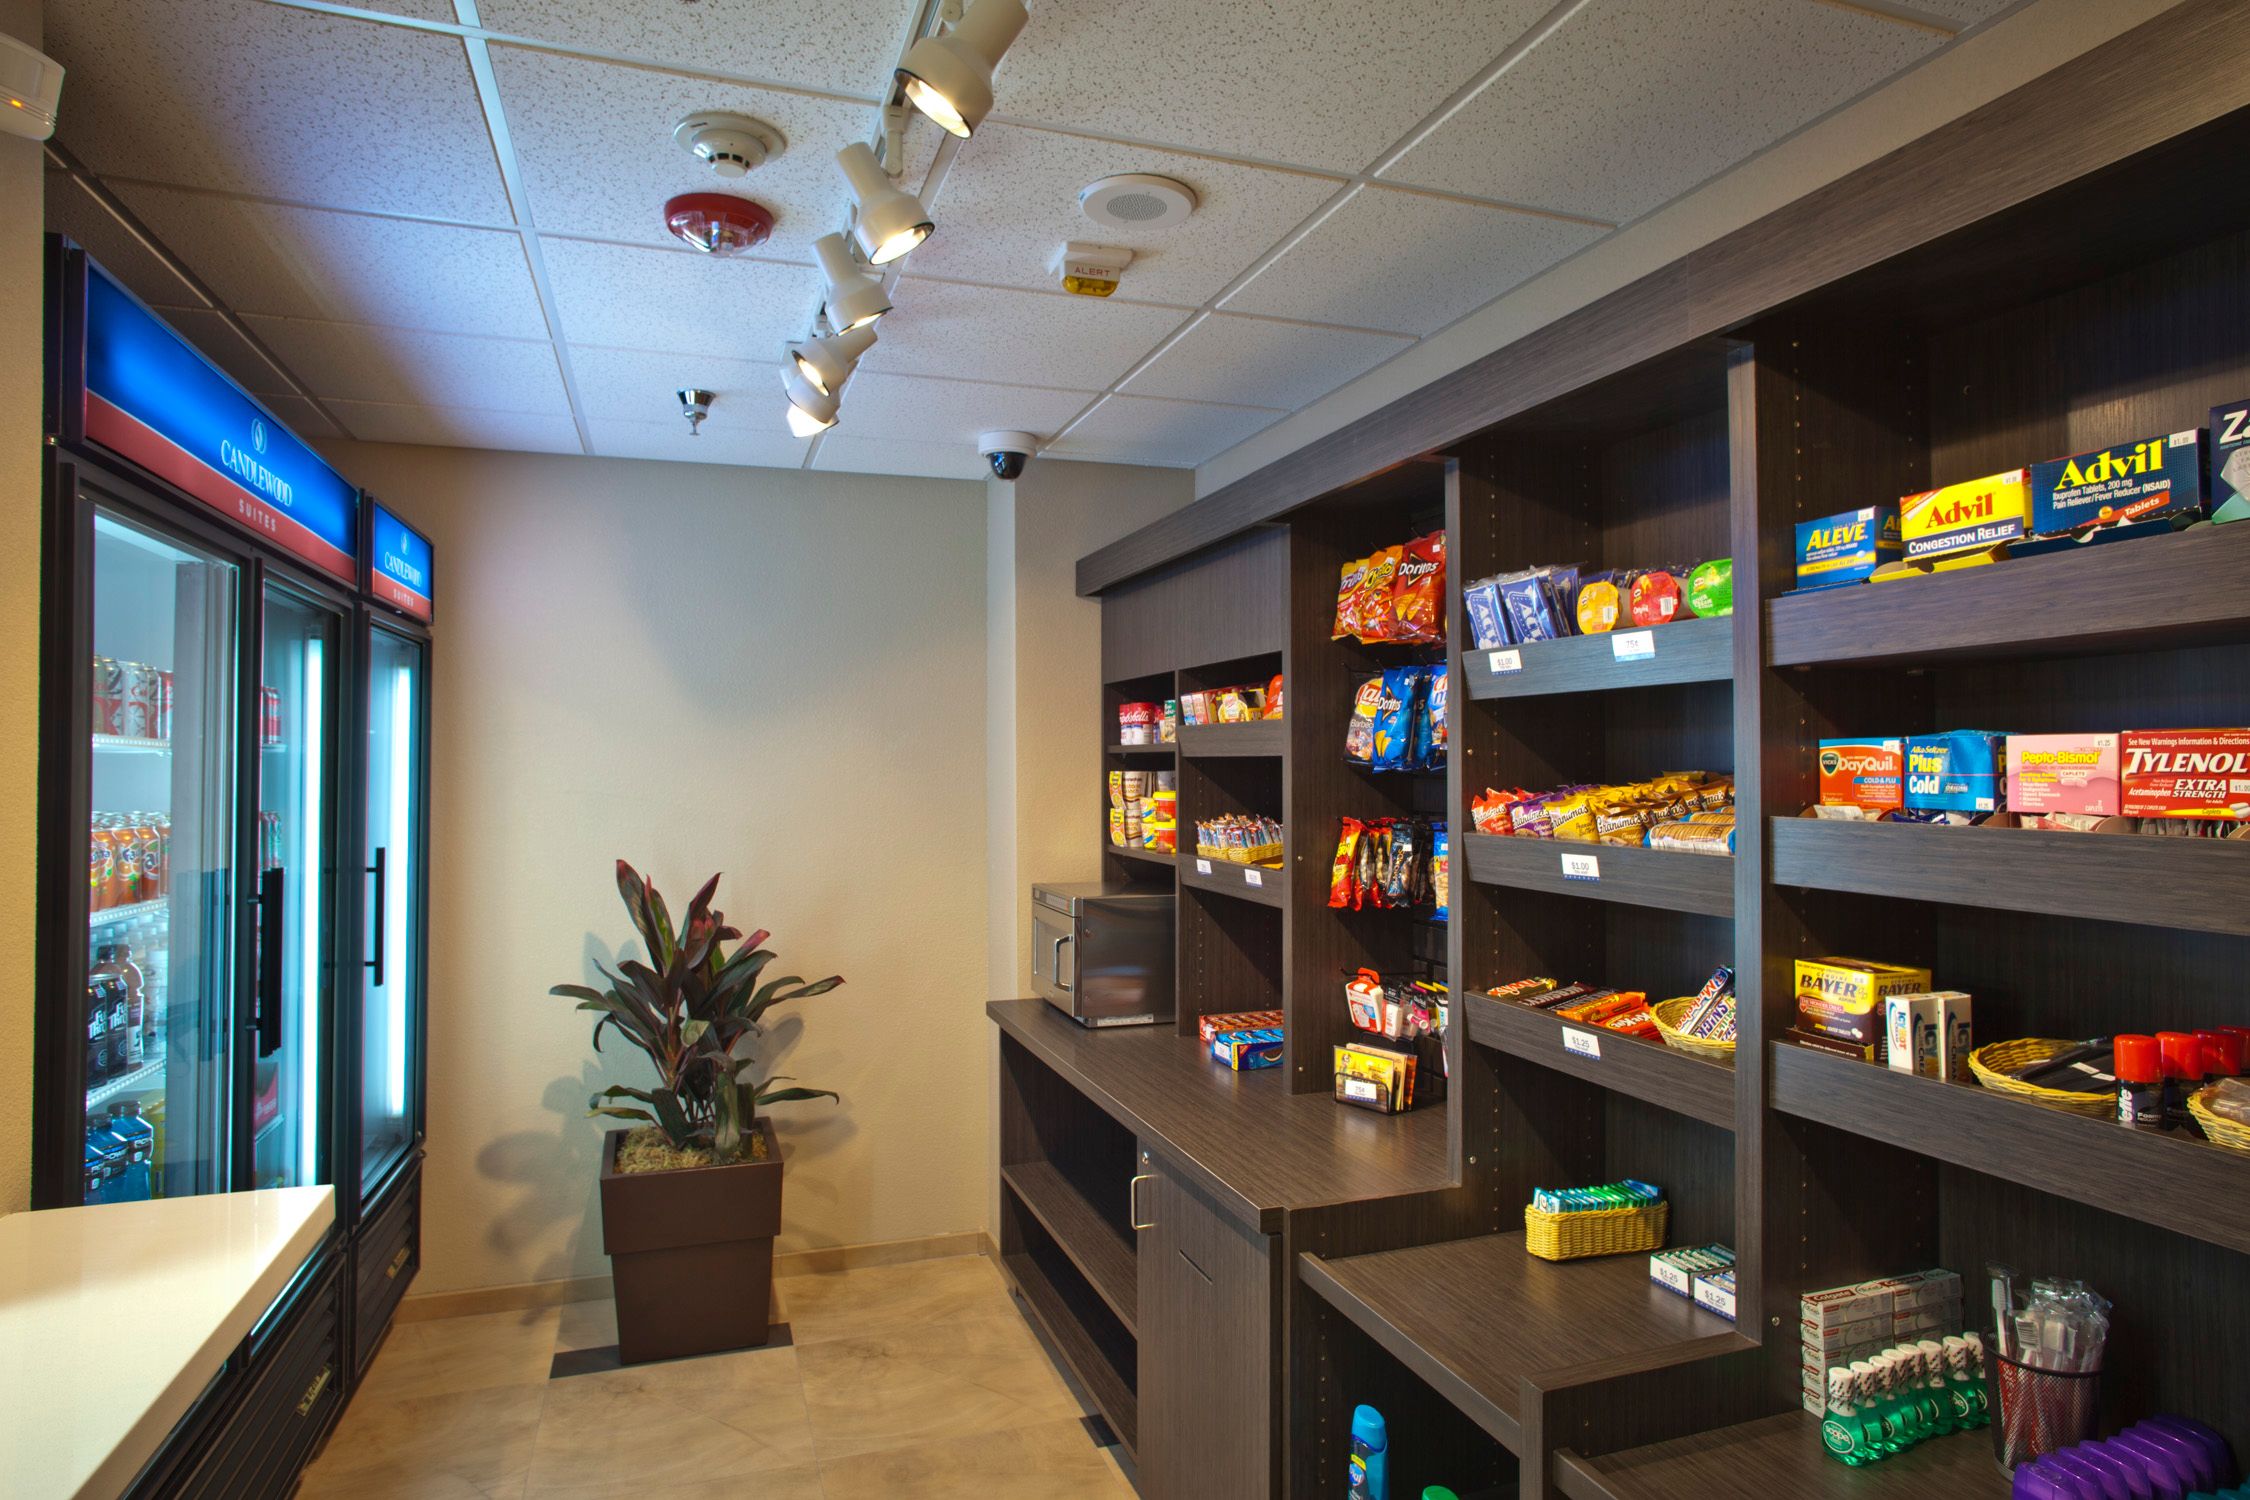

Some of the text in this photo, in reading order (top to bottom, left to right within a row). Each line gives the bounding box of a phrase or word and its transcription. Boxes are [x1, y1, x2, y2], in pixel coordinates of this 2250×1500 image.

[1074, 266, 1110, 276] ALERT
[221, 440, 292, 507] CANDLEWOOD
[2054, 439, 2163, 491] Advil
[2053, 488, 2081, 502] Ibuprofen
[2108, 480, 2120, 489] 200
[2121, 478, 2133, 488] mg
[2053, 500, 2067, 510] Pain
[2114, 486, 2141, 499] Reducer
[2142, 479, 2171, 493] (NSAID)
[1925, 493, 1993, 529] Advil
[2125, 497, 2160, 516] Tablets
[239, 499, 277, 532] SUITES
[1806, 521, 1866, 551] ALEVE
[1908, 523, 2016, 554] CONGESTION RELIEF
[384, 552, 422, 587] CANDLEWOOD
[1398, 561, 1439, 577] Doritos
[1497, 657, 1513, 666] $1.00
[1378, 696, 1402, 711] Doritos
[2128, 737, 2250, 747] See New Warnings Information & Directions
[1839, 756, 1893, 775] DayQuil
[1909, 754, 1943, 773] Plus
[2021, 751, 2099, 765] Pepto-Bismol
[2125, 748, 2248, 774] TYLENOL
[1909, 775, 1940, 794] Cold
[2128, 787, 2172, 798] Acetaminophen
[2174, 779, 2227, 790] EXTRA
[2172, 790, 2227, 799] STRENGTH
[1571, 861, 1590, 870] $1.00
[1800, 974, 1857, 998] BAYER
[1877, 983, 1921, 996] BAYER
[1572, 1036, 1590, 1050] $1.25
[1660, 1267, 1679, 1283] $1.25
[1704, 1290, 1726, 1306] $1.25
[1813, 1289, 1851, 1301] Colgate
